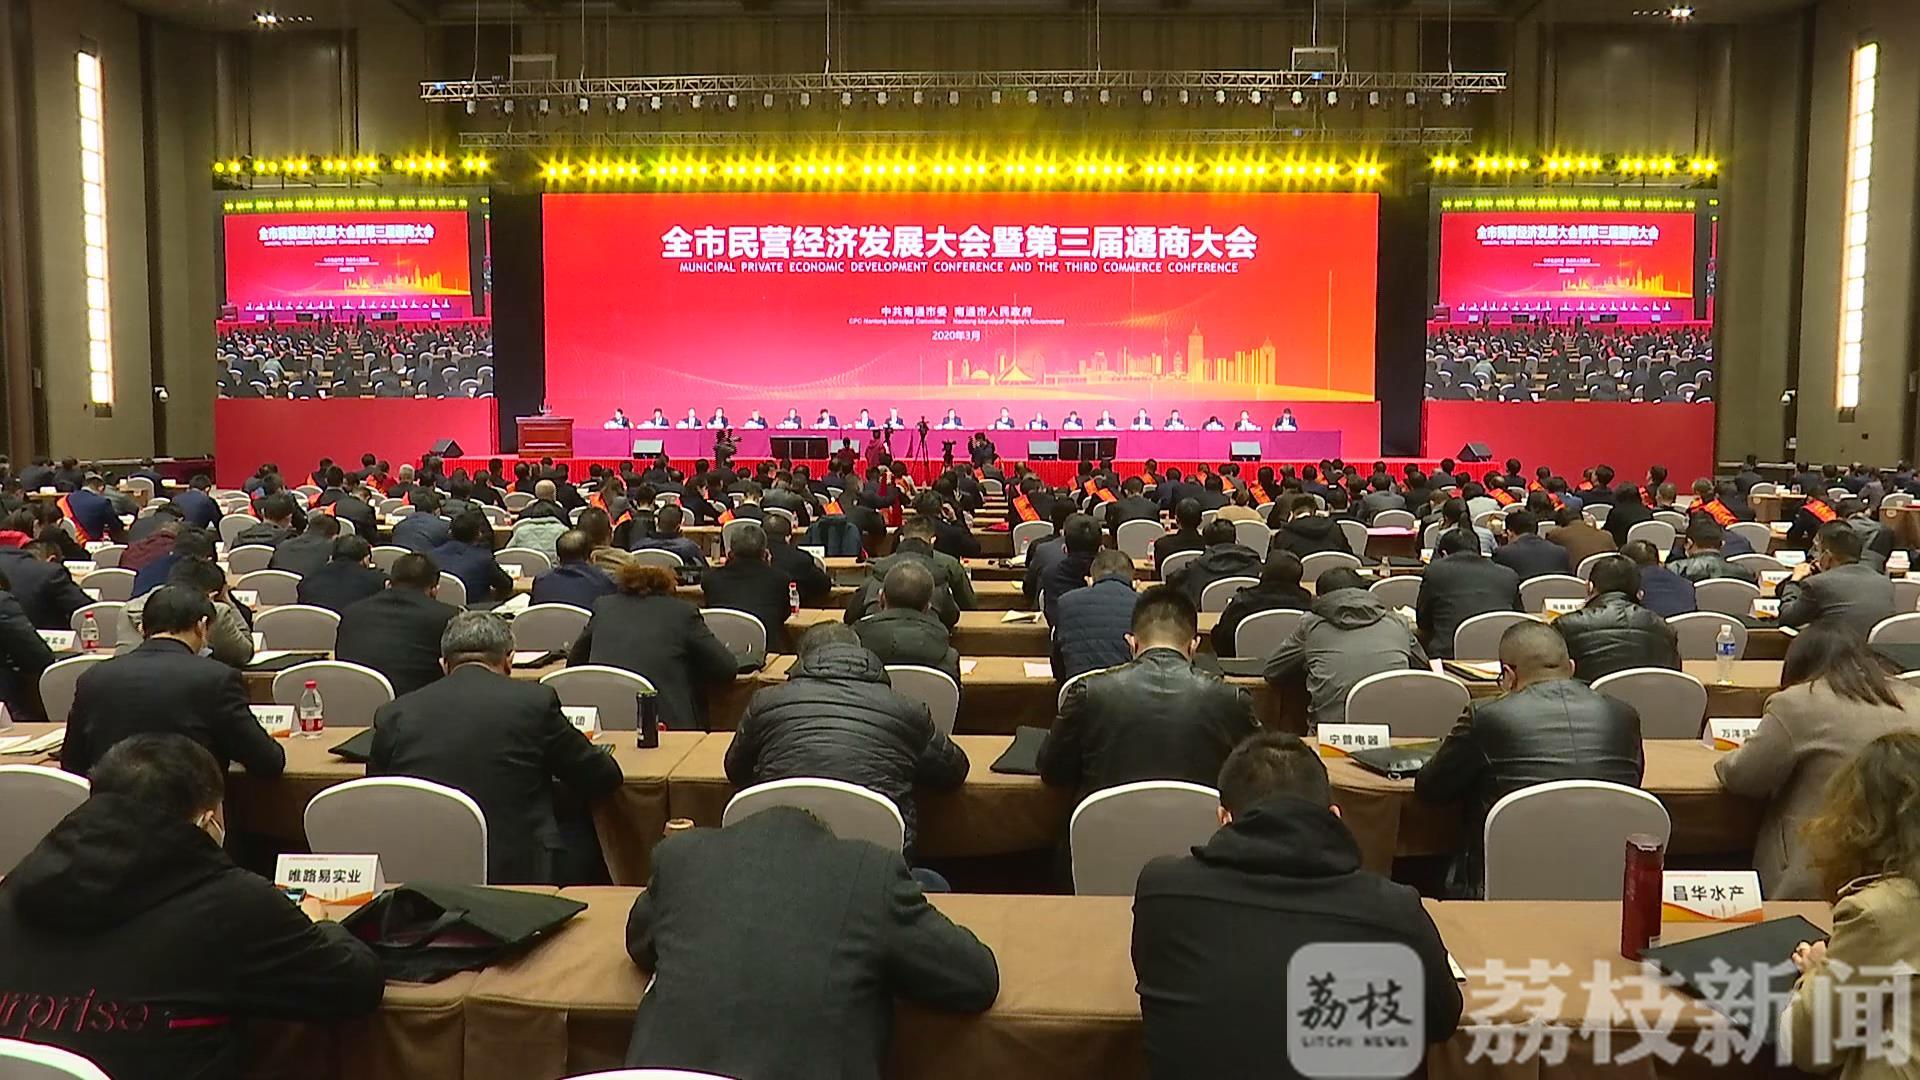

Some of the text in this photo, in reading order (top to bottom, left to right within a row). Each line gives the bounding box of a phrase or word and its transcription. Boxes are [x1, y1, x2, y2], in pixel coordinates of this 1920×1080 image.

[661, 225, 1257, 259] 全市民营经济发展大会暨第三届通商大会
[679, 262, 1239, 273] MUNICIPAL PRIVATE ECONOMIC DEVELOPMENT CONFERENCE AND THE THIRD COMMERCE CONFERENCE
[881, 306, 1033, 318] 中共南通市委 南通市人民政府
[931, 330, 981, 342] 2020年3月
[287, 868, 362, 884] 唯路易实业
[1672, 885, 1745, 902] 昌华水产
